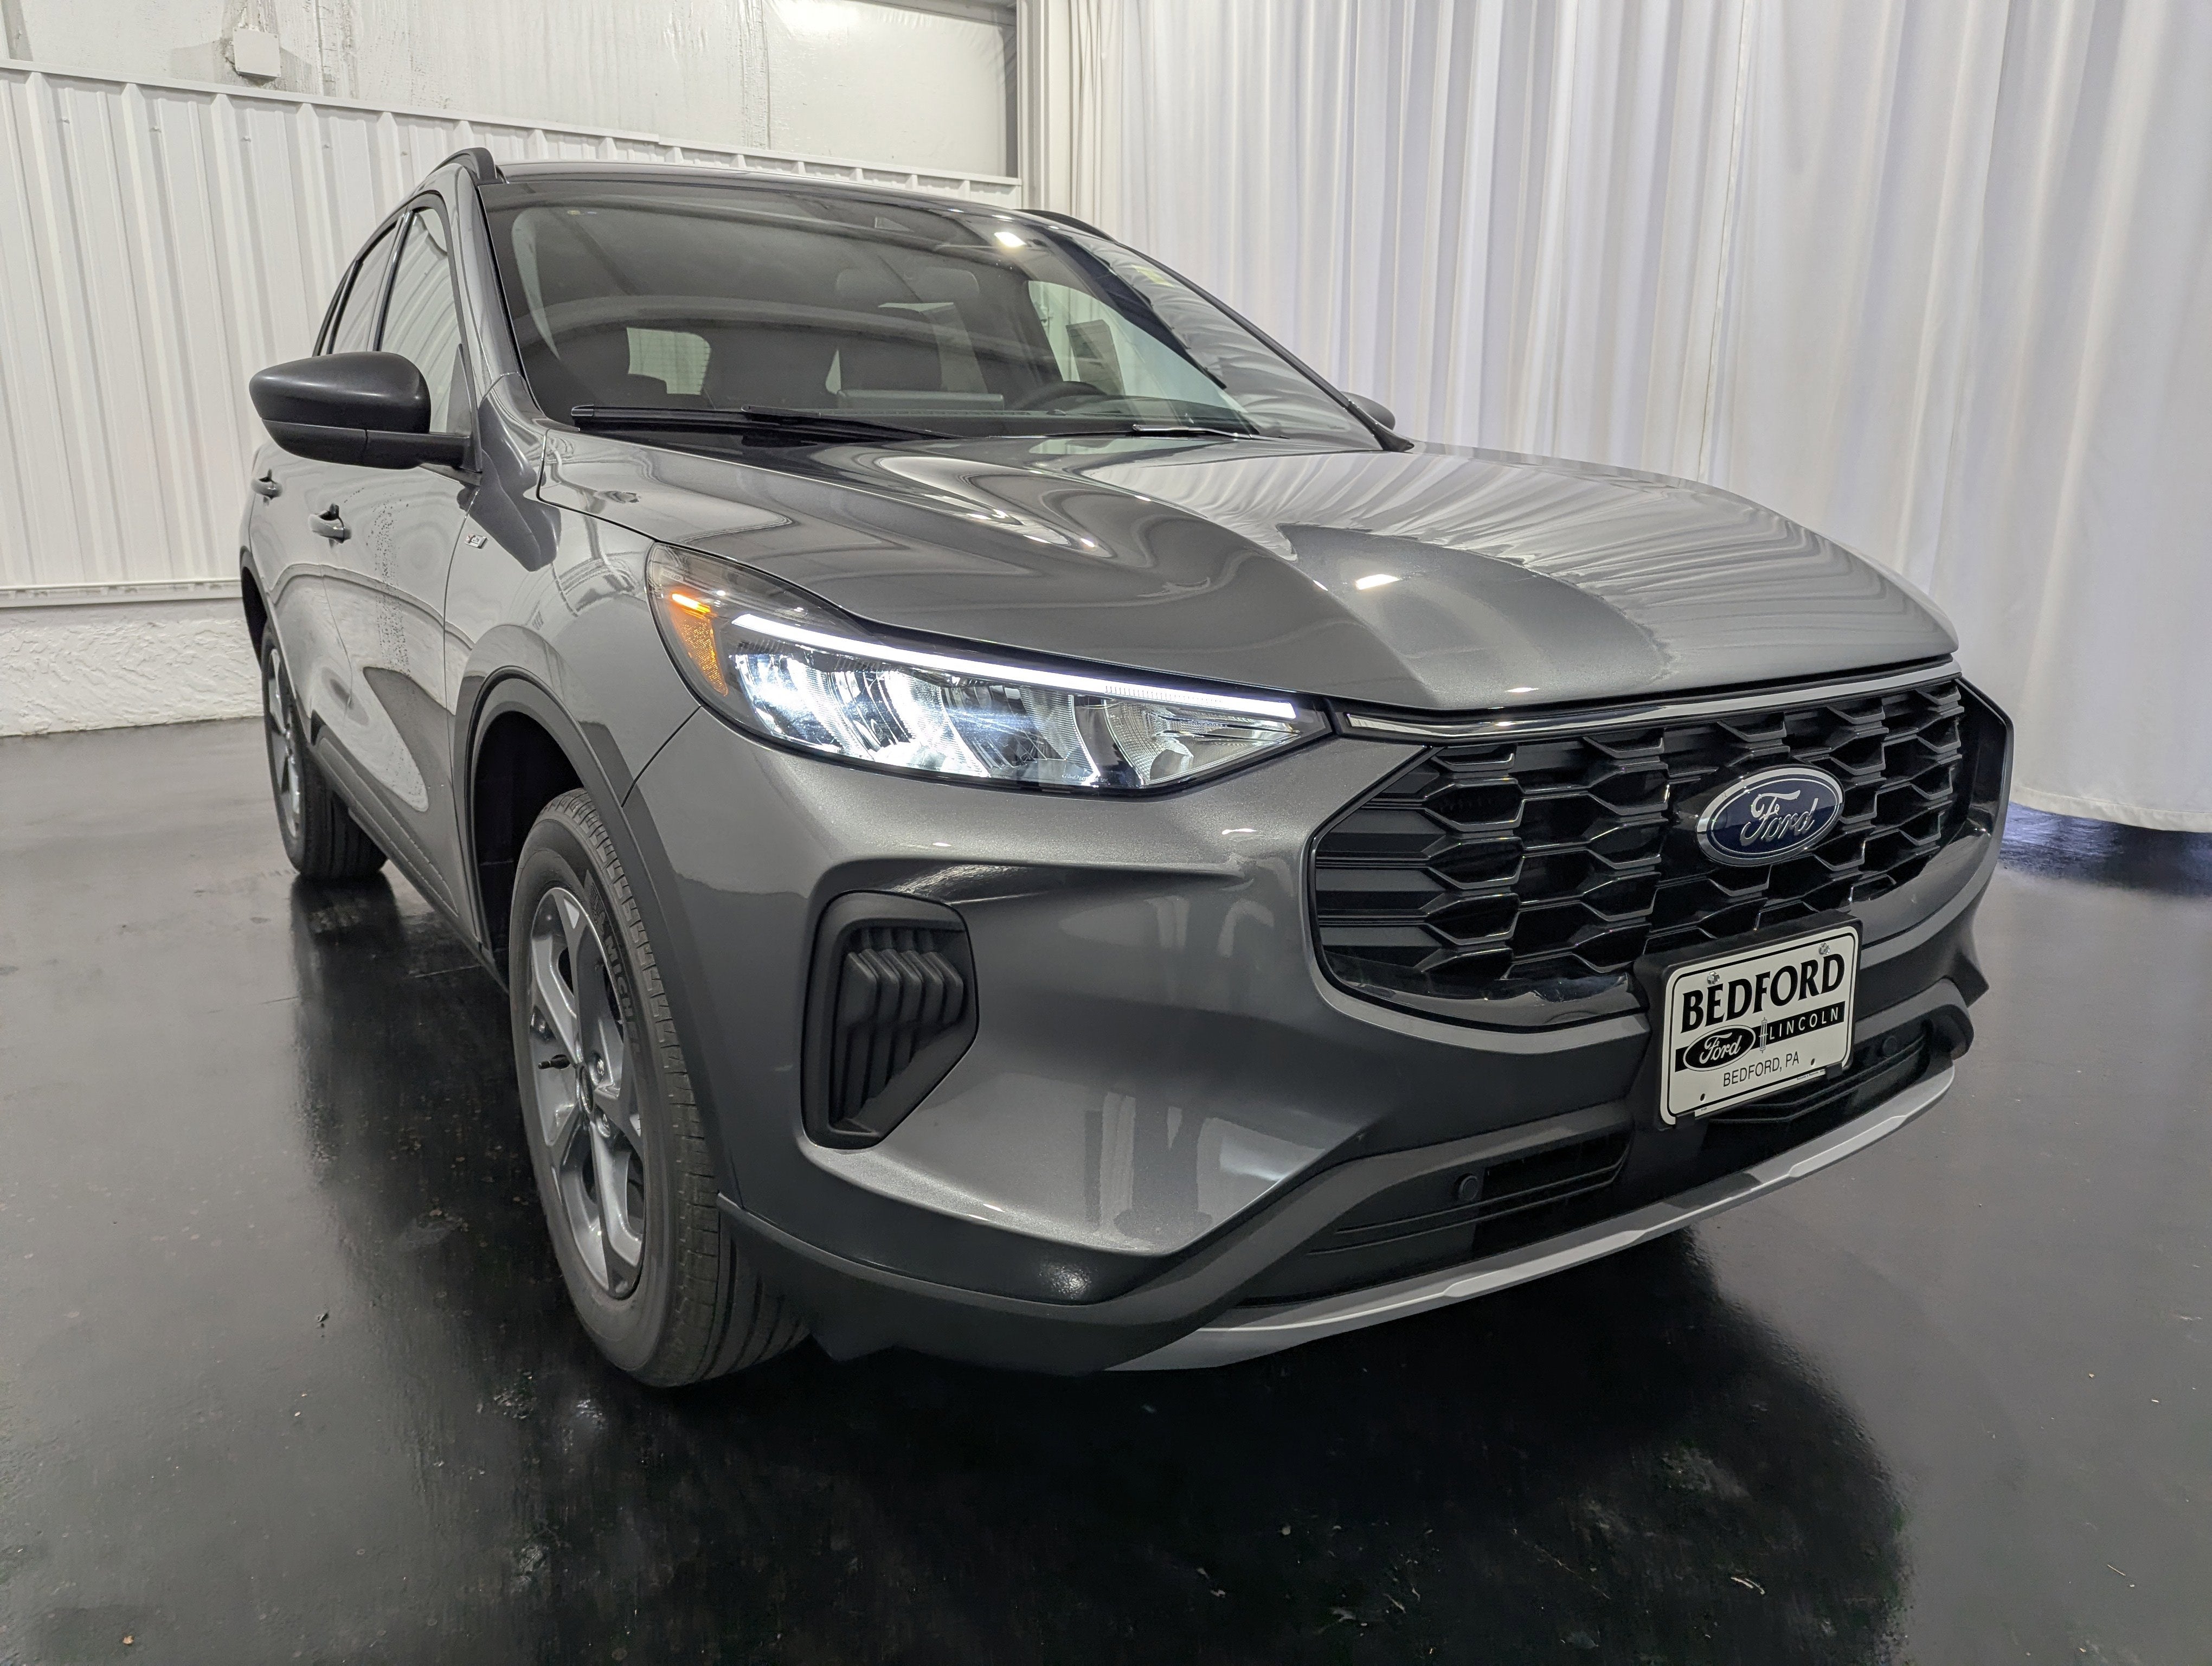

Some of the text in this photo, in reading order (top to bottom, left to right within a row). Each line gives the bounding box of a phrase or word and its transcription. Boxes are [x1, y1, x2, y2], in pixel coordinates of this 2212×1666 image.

[1739, 790, 1818, 847] Ford
[604, 935, 641, 1054] MICHEL
[1680, 953, 1845, 1034] BEDFORD
[1769, 1007, 1838, 1040] LINCOLN
[1699, 1031, 1742, 1064] Ford
[1723, 1057, 1782, 1087] BEDFORD,
[1785, 1051, 1799, 1068] PA
